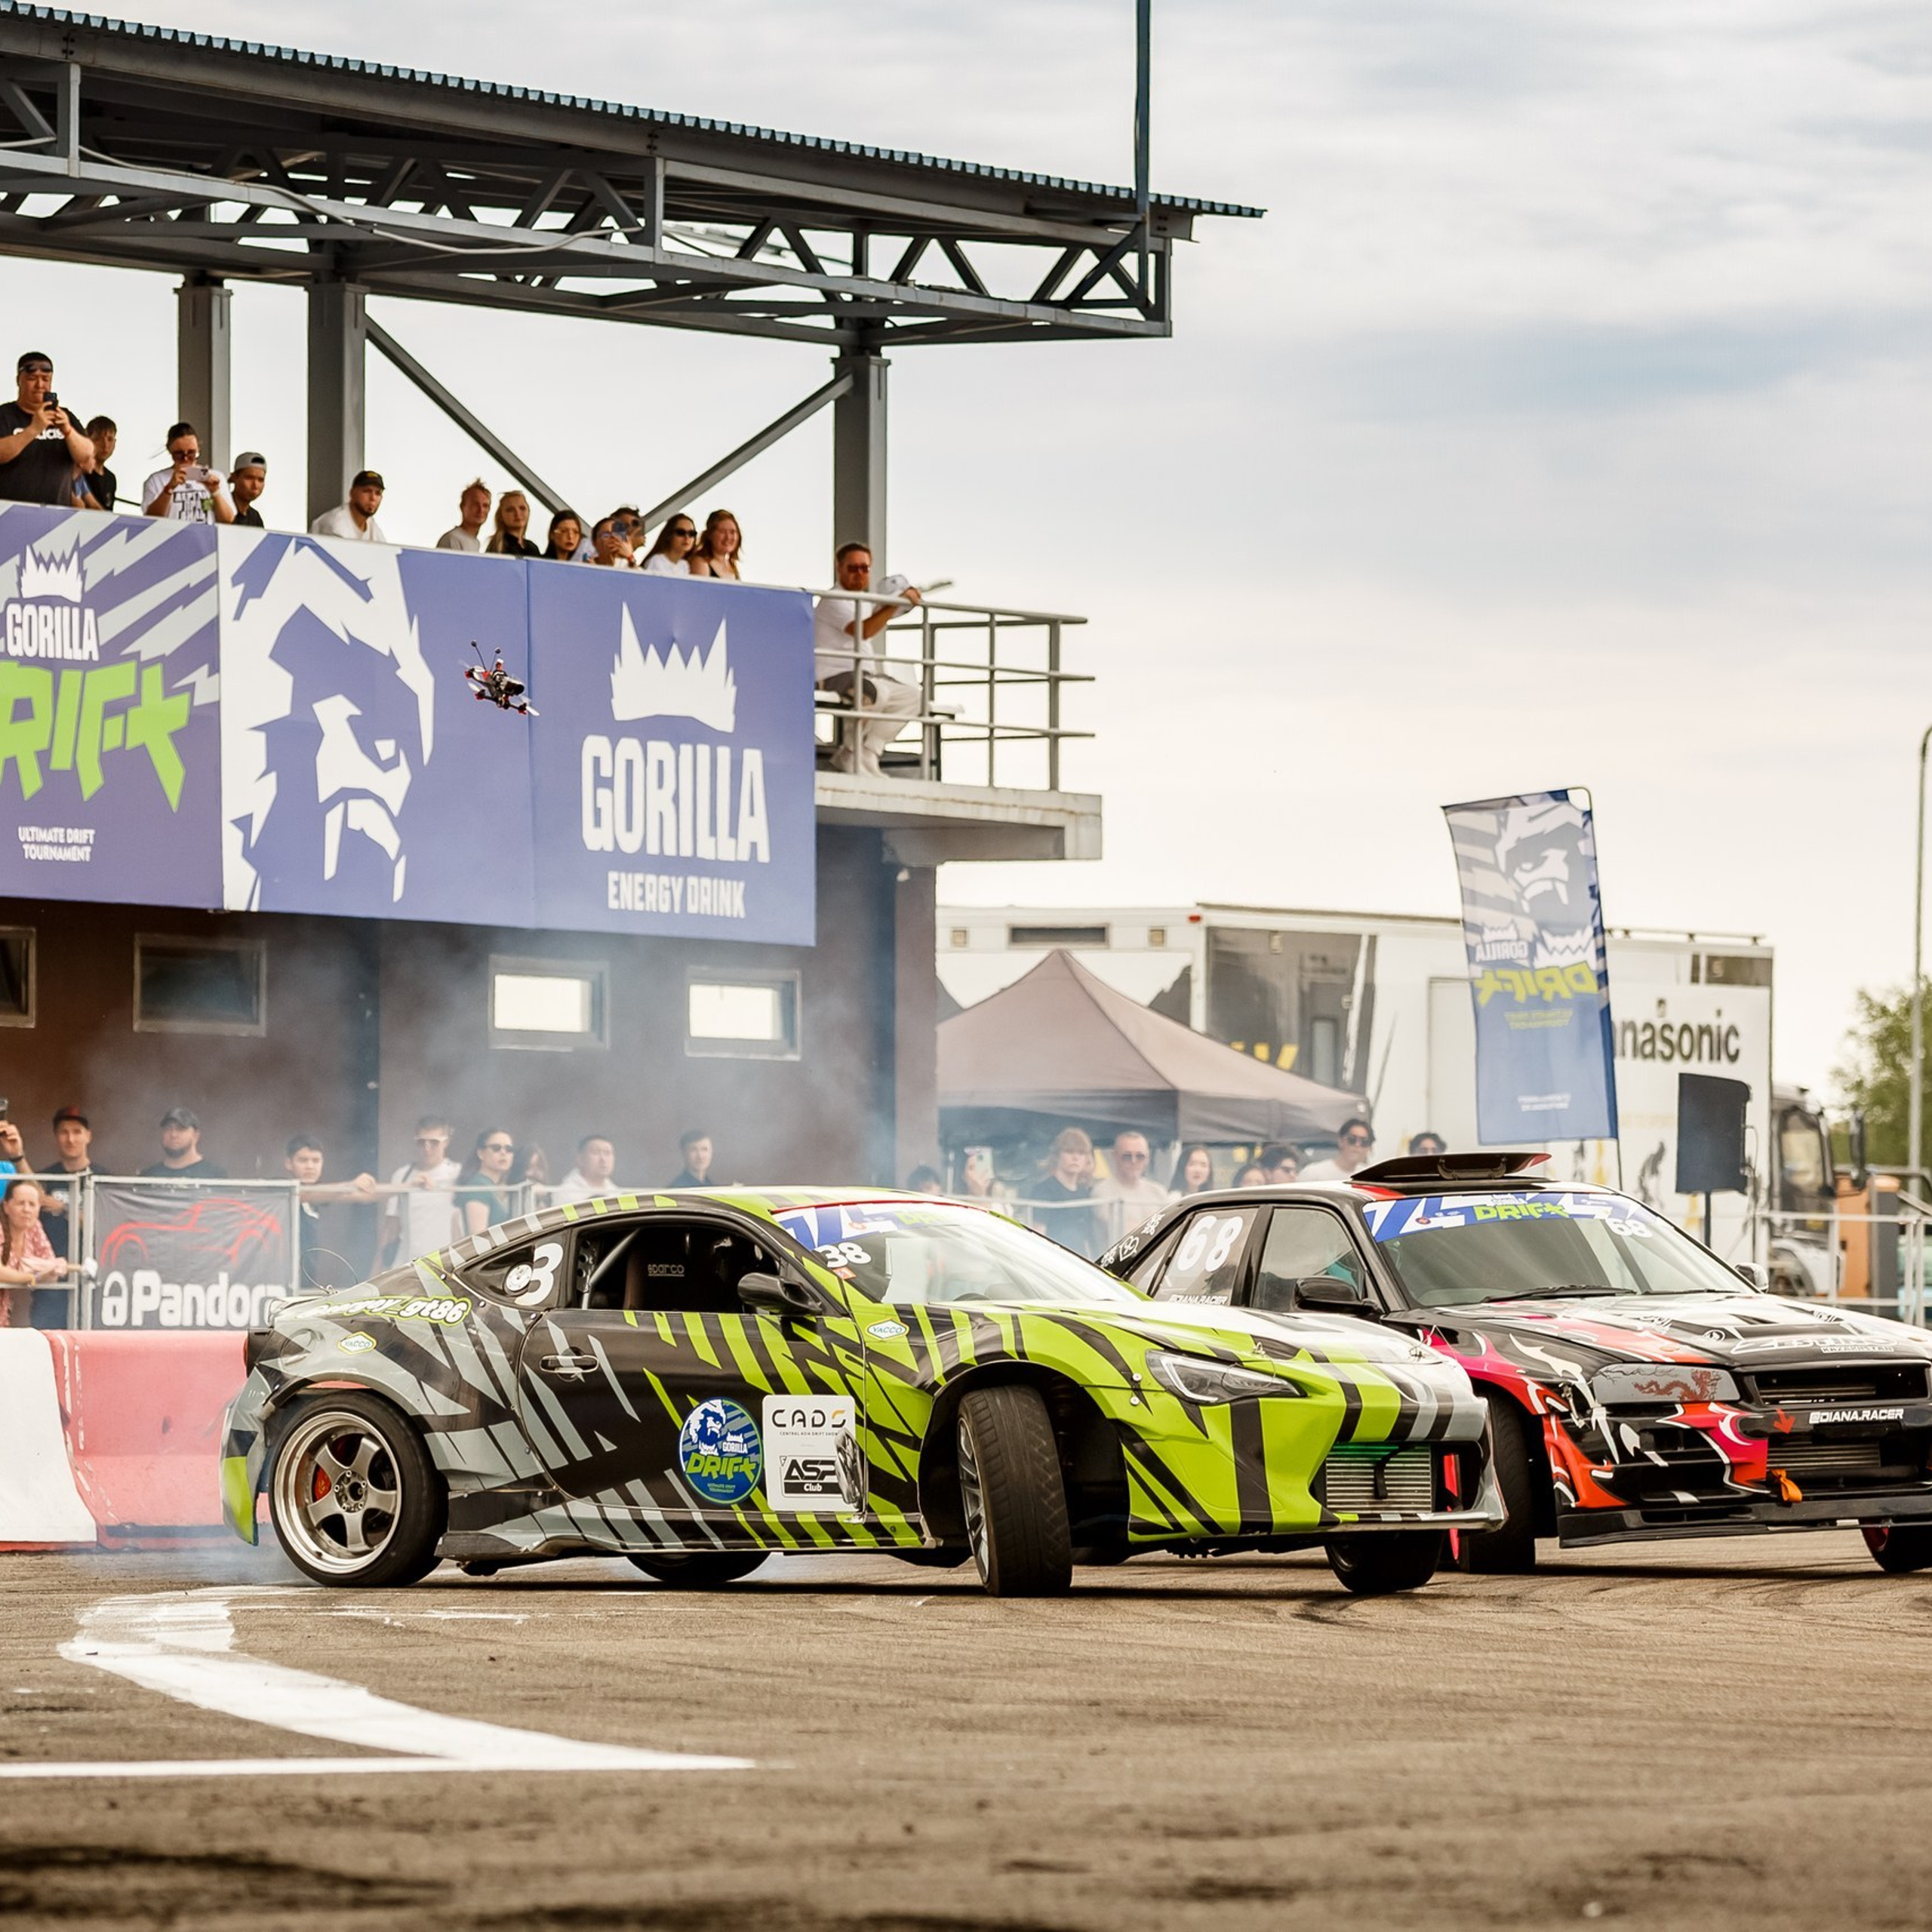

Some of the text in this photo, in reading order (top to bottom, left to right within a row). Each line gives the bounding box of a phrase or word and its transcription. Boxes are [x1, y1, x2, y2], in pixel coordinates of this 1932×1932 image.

[6, 603, 100, 662] GORILLA
[0, 660, 191, 814] RIFT
[581, 734, 771, 863] GORILLA
[18, 826, 96, 844] ULTIMATE DRIFT
[23, 844, 92, 862] TOURNAMENT
[608, 870, 746, 918] ENERGY DRINK
[1612, 1009, 1740, 1063] nasonic
[1605, 1217, 1654, 1238] 68
[814, 1241, 872, 1268] 38
[1177, 1215, 1244, 1272] 68
[872, 1326, 903, 1334] YACCO
[772, 1409, 846, 1428] CADS
[1809, 1408, 1905, 1425] @DIANA.RACER
[722, 1441, 749, 1454] GORILLA
[685, 1451, 757, 1484] DRIFT
[804, 1482, 823, 1493] Club
